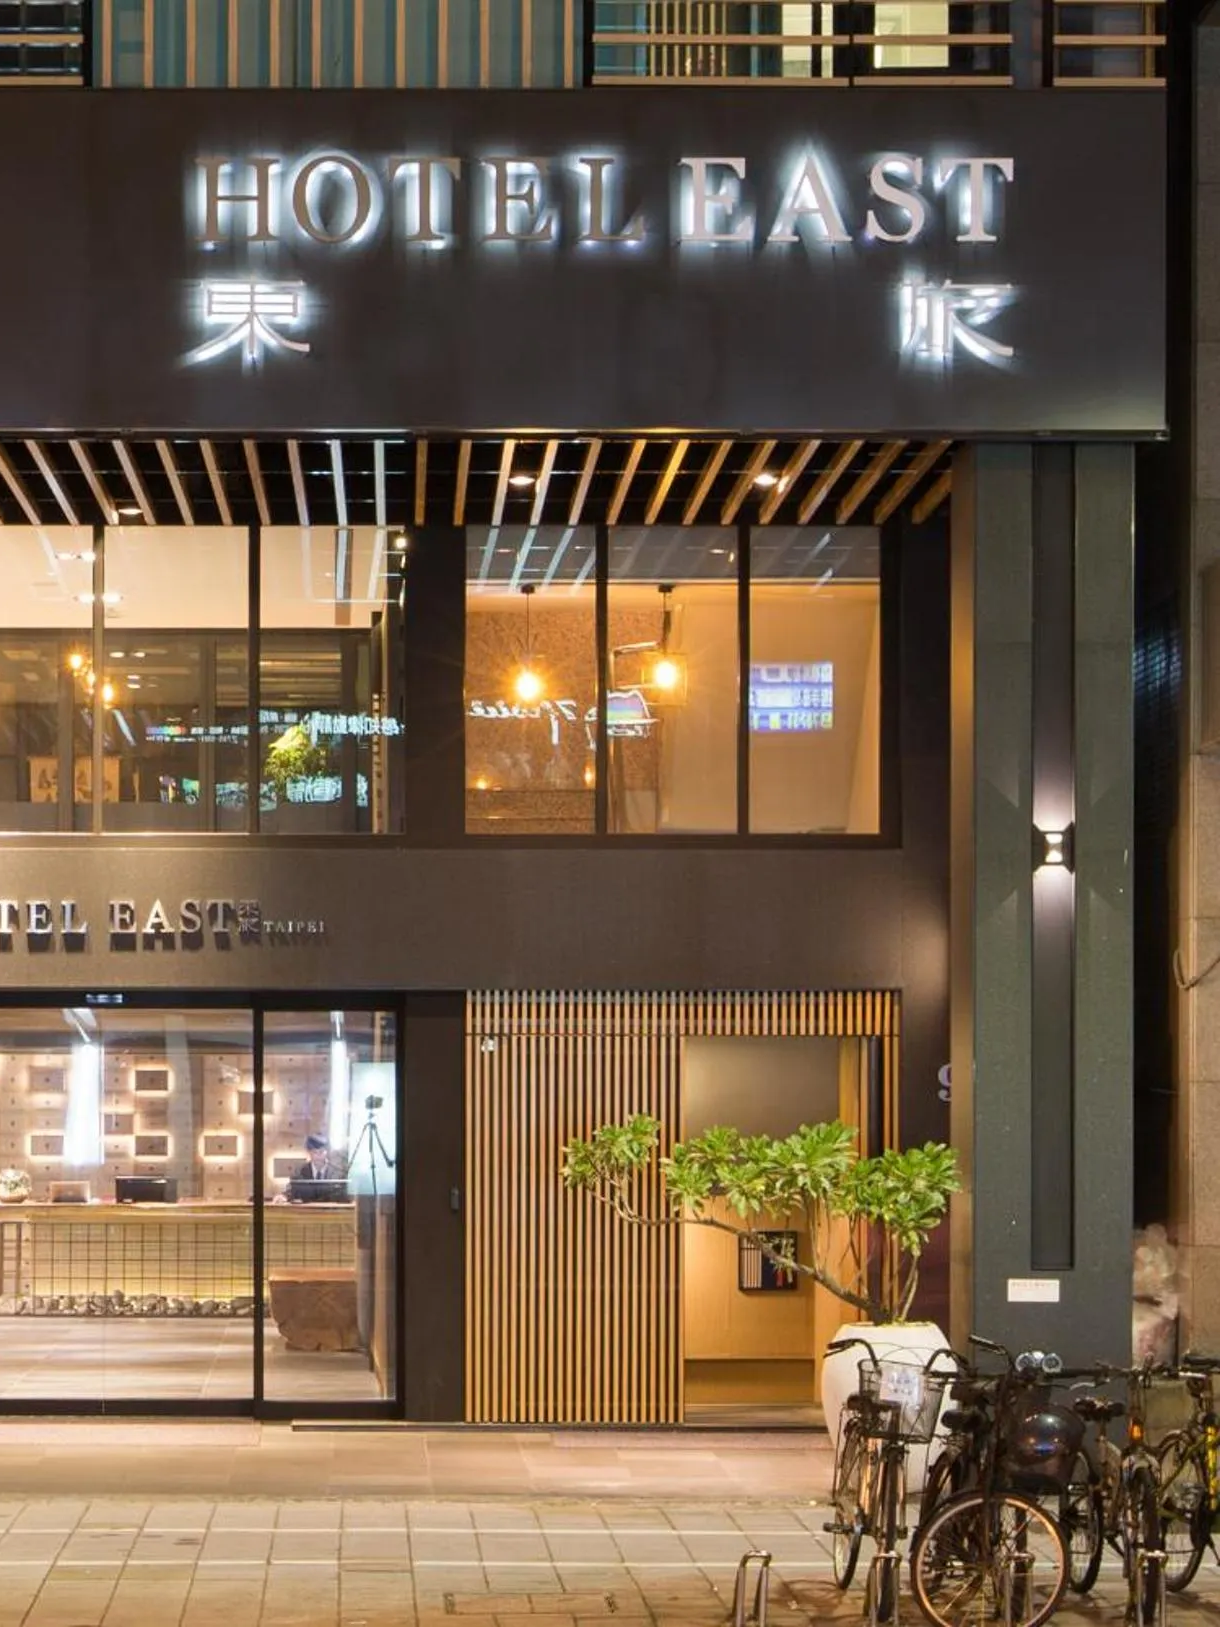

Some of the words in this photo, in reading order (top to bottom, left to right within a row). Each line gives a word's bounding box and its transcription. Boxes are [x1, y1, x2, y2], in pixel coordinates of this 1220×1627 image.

[194, 155, 644, 243] HOTEL
[678, 153, 1014, 242] EAST
[186, 275, 311, 358] 東
[109, 898, 232, 934] EAST
[263, 920, 325, 934] TAIPEI
